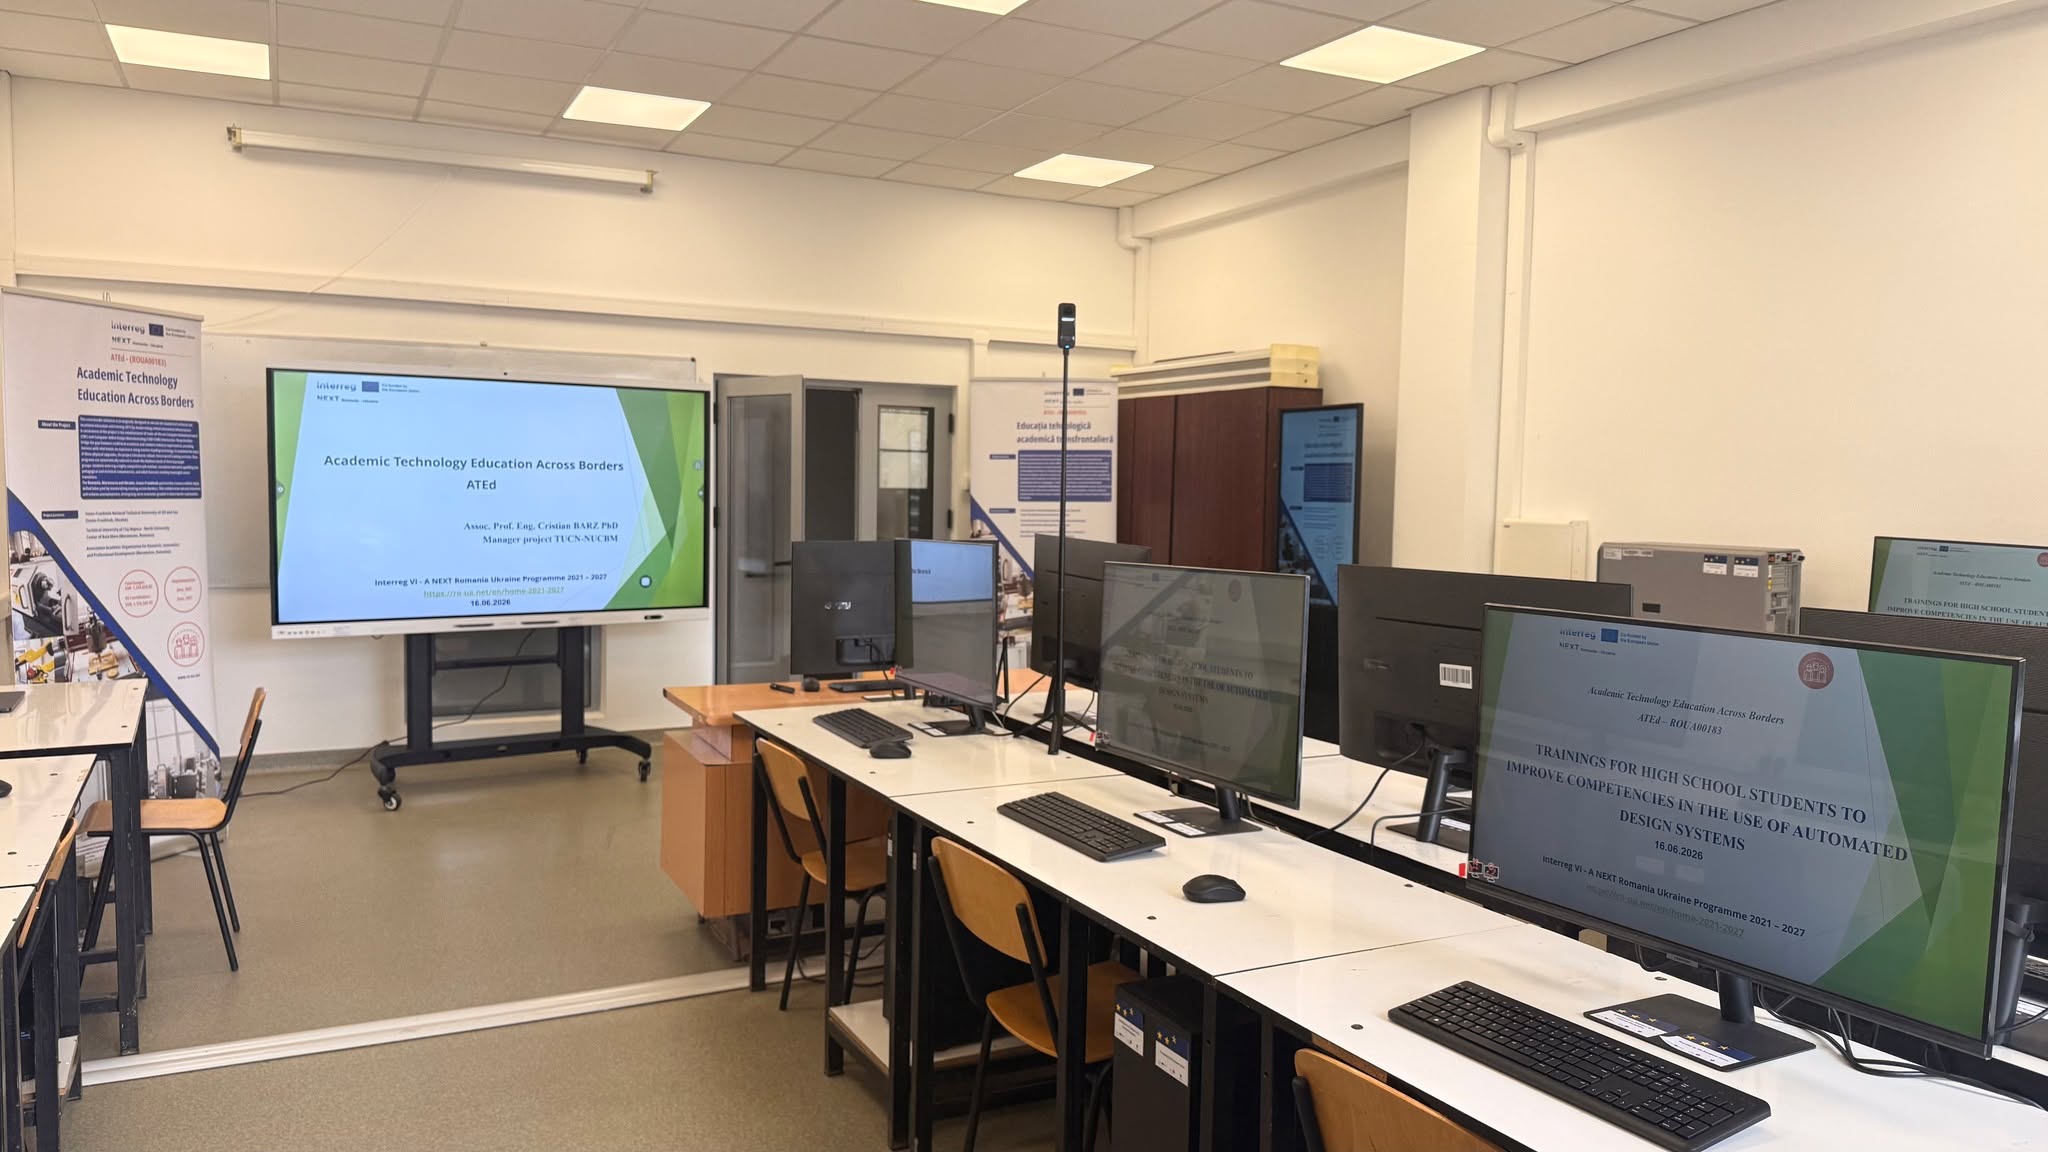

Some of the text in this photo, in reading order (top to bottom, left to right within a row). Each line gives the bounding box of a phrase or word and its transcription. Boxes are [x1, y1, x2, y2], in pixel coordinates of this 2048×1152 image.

[76, 366, 178, 390] Academic Technology
[78, 388, 195, 409] Education Across Borders
[1049, 422, 1092, 431] tehologică
[1056, 435, 1114, 444] trnsfrontalieră
[324, 456, 624, 471] Academic Technology Education Across Borders
[466, 480, 497, 490] ATEd
[494, 522, 514, 531] Prof.
[538, 522, 571, 530] Cristian
[574, 522, 599, 530] BARZ
[602, 522, 619, 530] PhD
[482, 536, 521, 545] Manager
[523, 535, 552, 545] project
[375, 579, 408, 587] Interreg
[522, 575, 566, 583] Programme
[1888, 606, 1918, 614] IMPROVE
[1904, 598, 1942, 607] TRAININGS
[1960, 603, 1980, 611] HIGH
[1981, 605, 2011, 614] SCHOOL
[1588, 687, 1785, 725] Academic Technology Education Across Borders
[1638, 714, 1661, 725] ATEd
[1670, 718, 1723, 735] ROUA00183
[1536, 744, 1866, 824] TRAININGS FOR HIGH SCHOOL STUDENTS TO
[1506, 760, 1908, 862] IMPROVE COMPETENCIES IN THE USE OF AUTOMATED
[1619, 809, 1745, 851] DESIGN SYSTEMS
[1654, 841, 1704, 860] 16.06.2026
[1543, 856, 1573, 872] Interreg
[1588, 868, 1594, 876] A
[1595, 871, 1617, 883] NEXT
[1619, 875, 1655, 894] Romania
[1657, 888, 1692, 905] Ukraine
[1694, 898, 1748, 921] Programme
[1750, 914, 1771, 928] 2021
[1782, 923, 1806, 937] 2027
